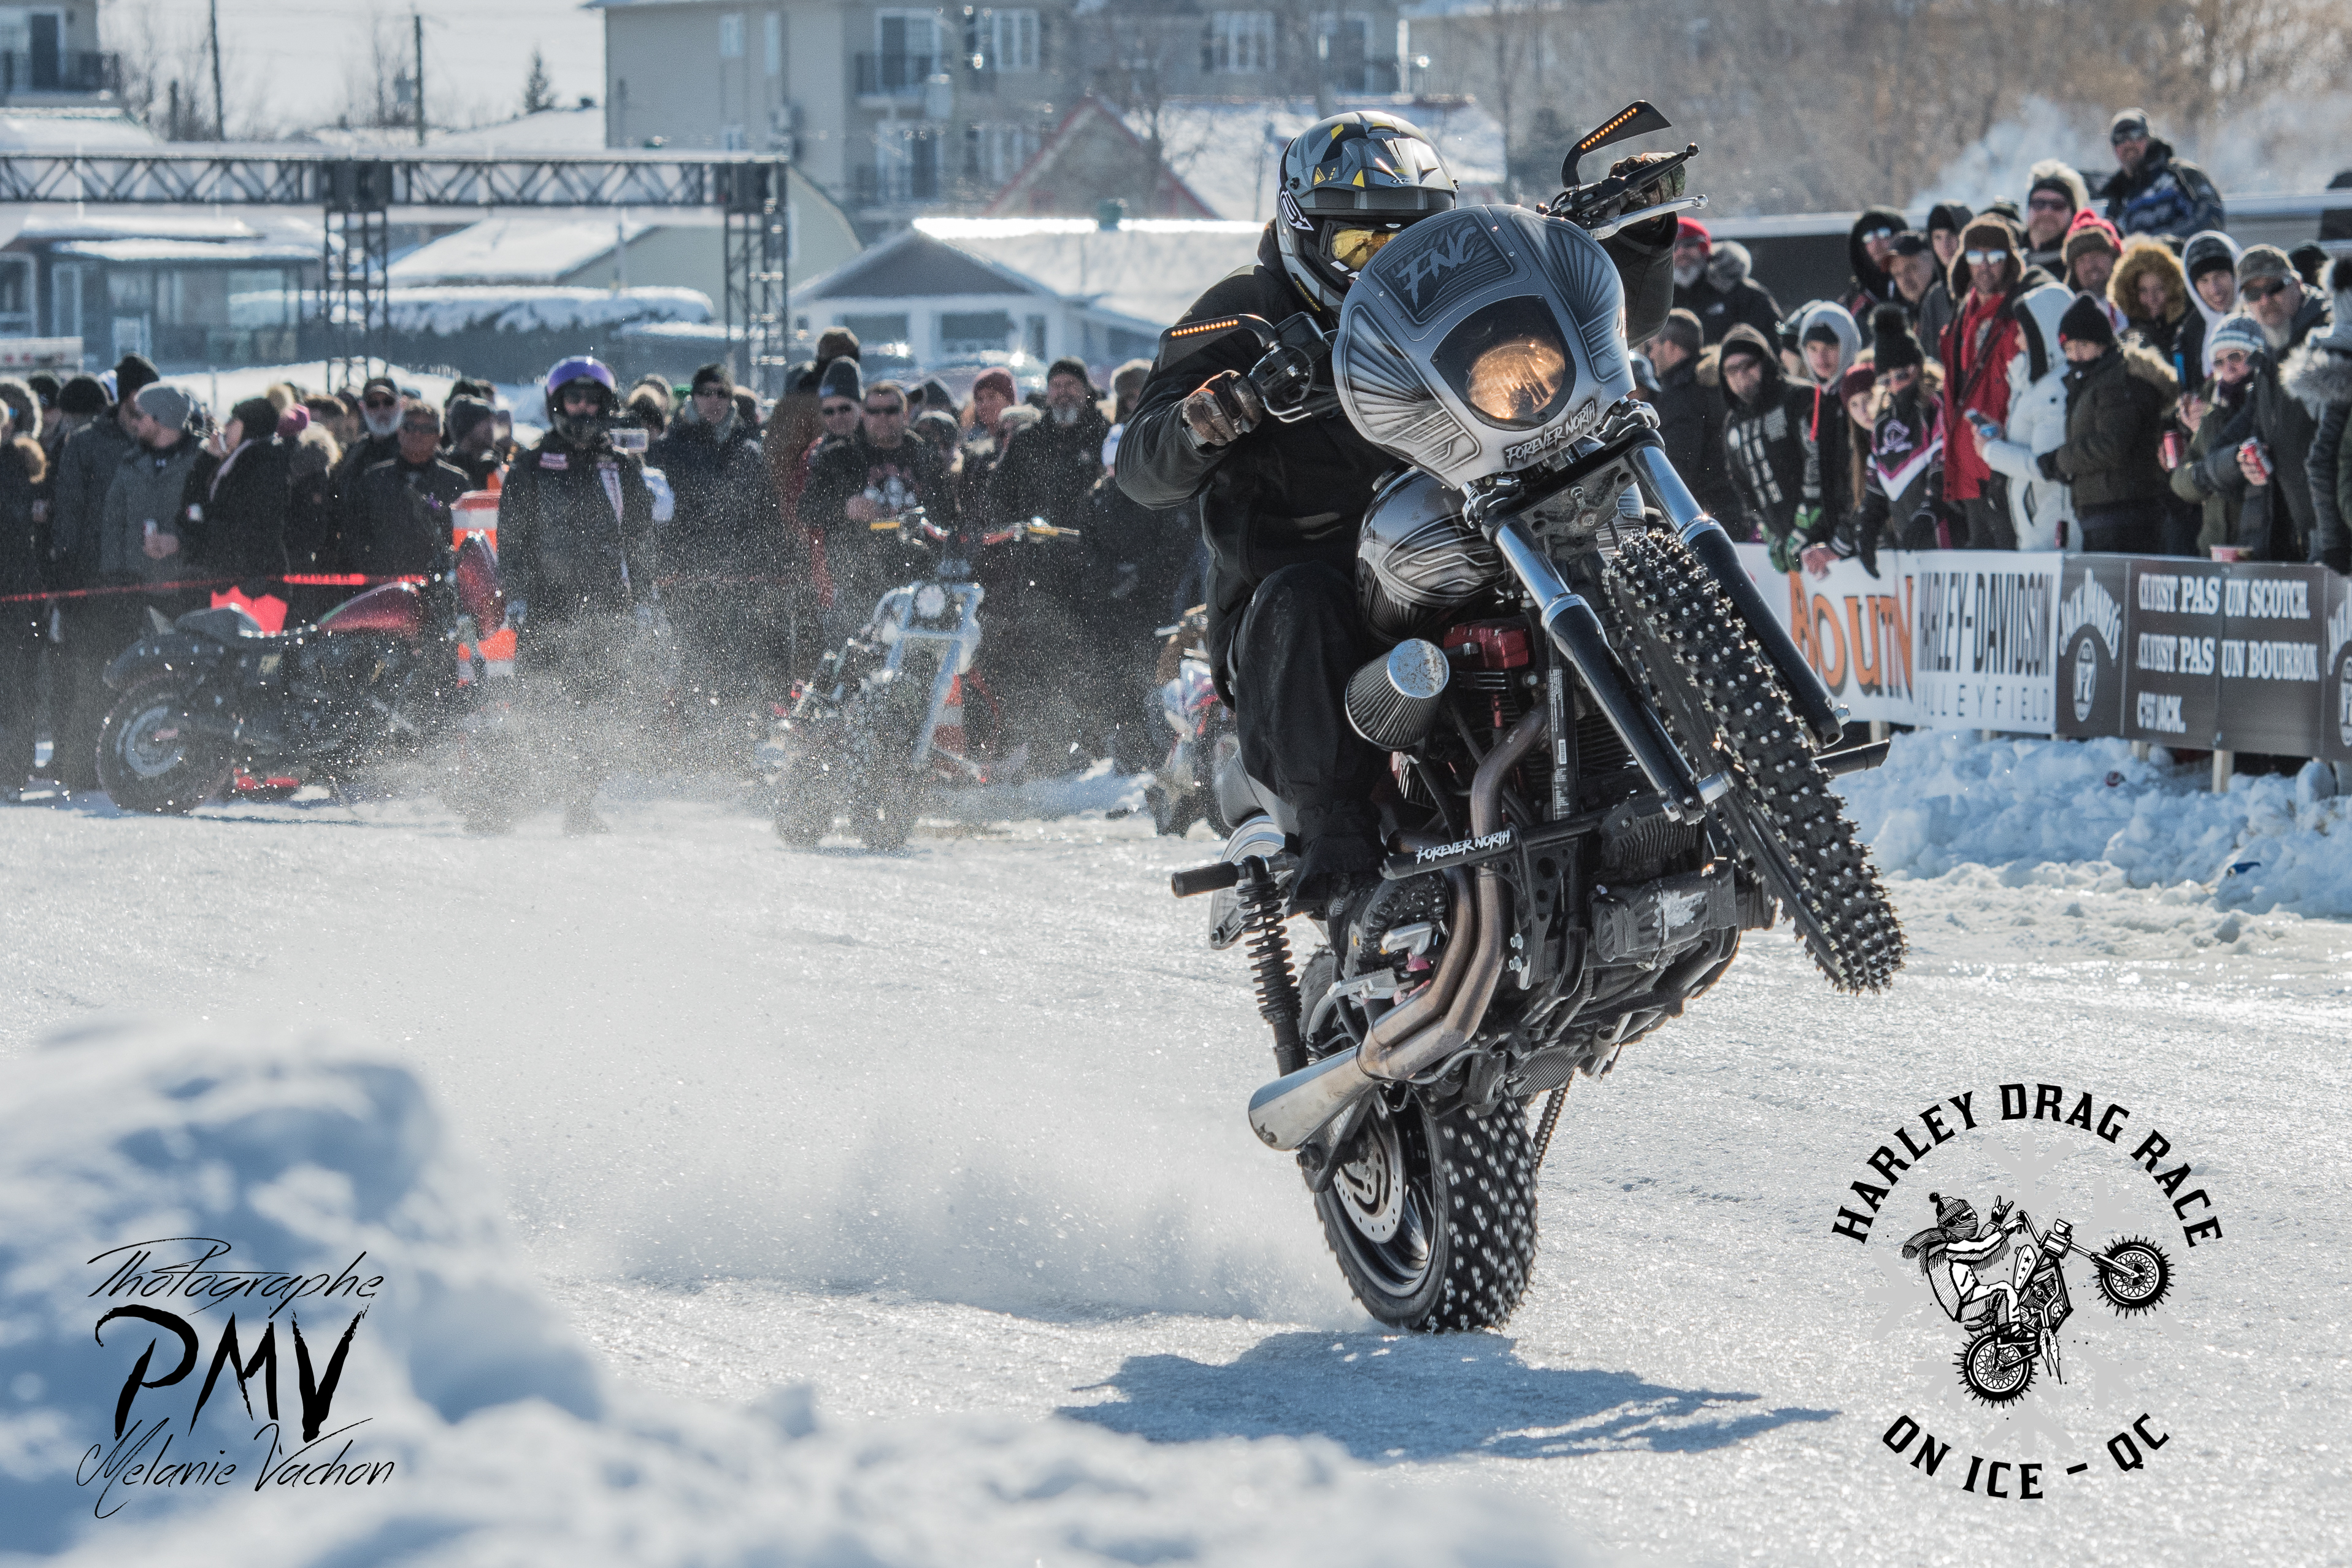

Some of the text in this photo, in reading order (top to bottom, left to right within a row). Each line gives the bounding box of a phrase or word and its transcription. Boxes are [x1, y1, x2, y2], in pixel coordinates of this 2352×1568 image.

[1505, 400, 1596, 466] FOREVER NORTH
[2180, 575, 2221, 615] PAS
[2224, 578, 2250, 617] UN
[2178, 636, 2216, 675] PAS
[2221, 639, 2246, 678] UN
[1415, 829, 1510, 864] FOREVER NORTH
